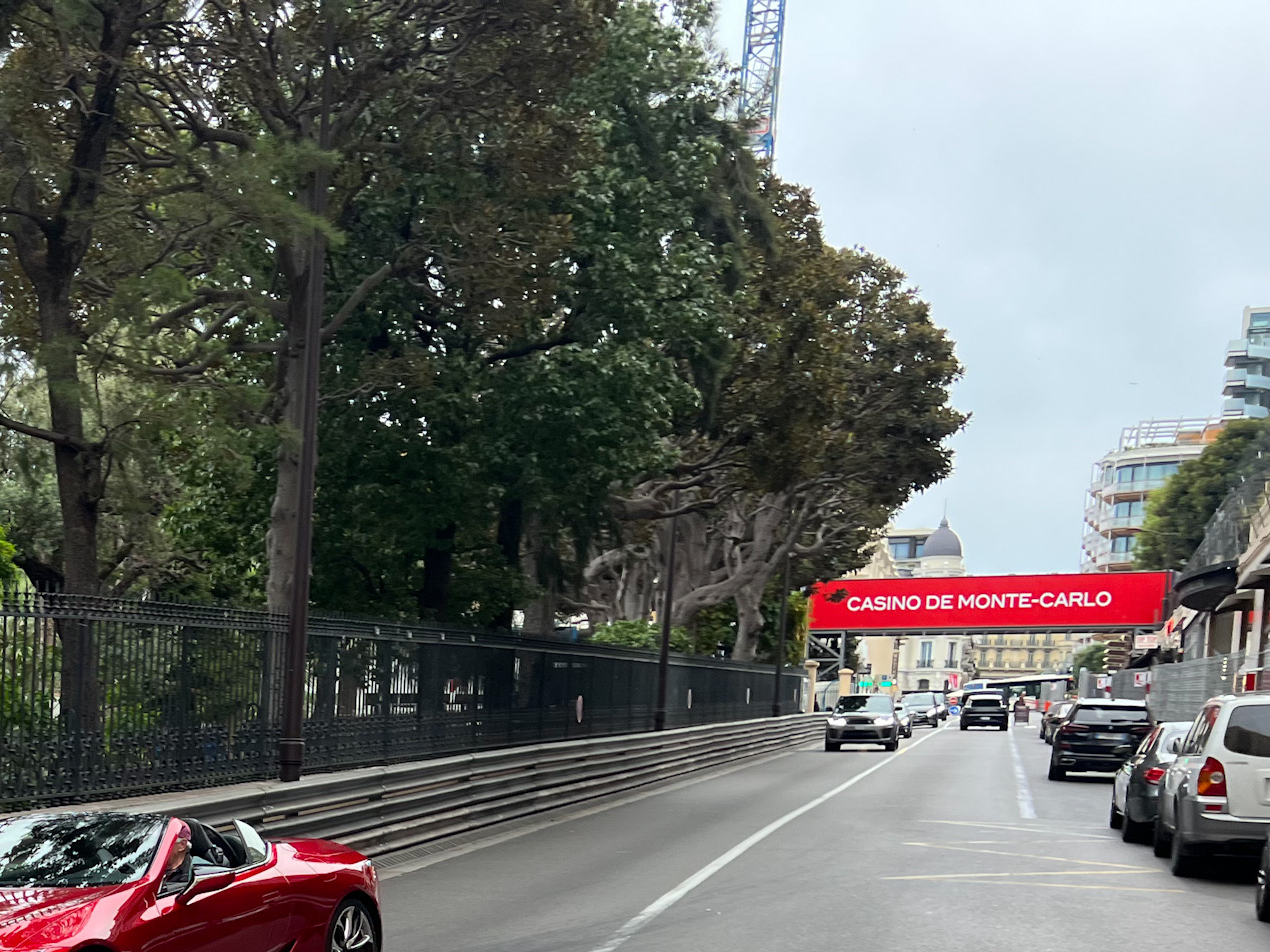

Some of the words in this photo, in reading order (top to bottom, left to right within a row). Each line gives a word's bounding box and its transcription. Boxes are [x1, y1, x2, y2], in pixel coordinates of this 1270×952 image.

[846, 595, 922, 612] CASINO
[925, 594, 954, 610] DE
[957, 590, 1112, 610] MONTE-CARLO
